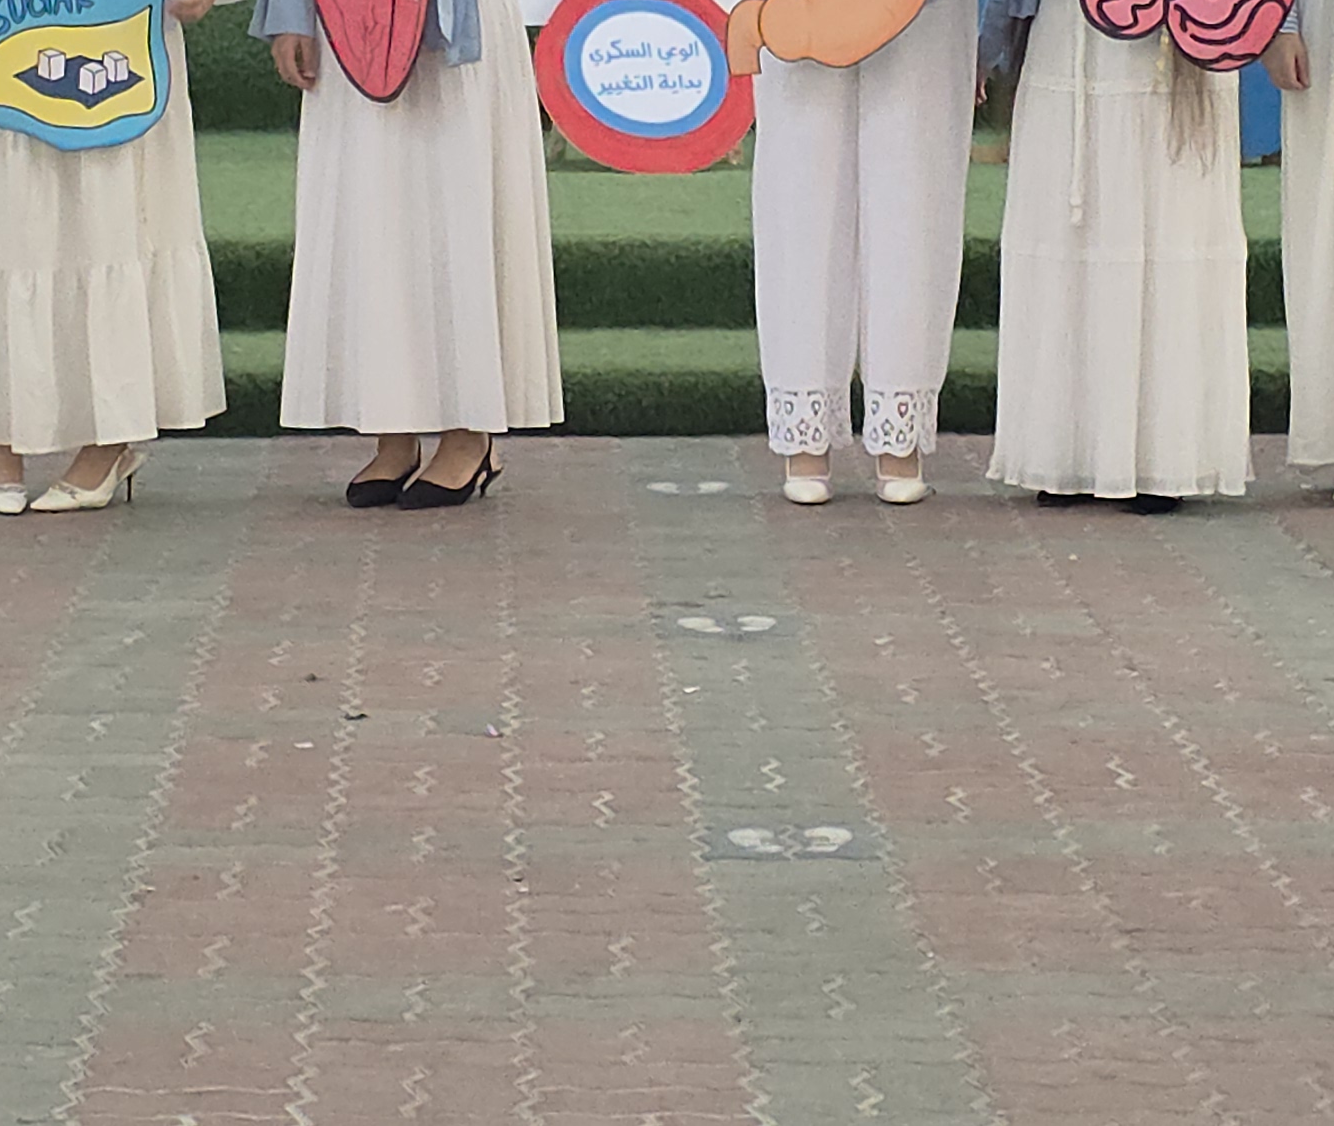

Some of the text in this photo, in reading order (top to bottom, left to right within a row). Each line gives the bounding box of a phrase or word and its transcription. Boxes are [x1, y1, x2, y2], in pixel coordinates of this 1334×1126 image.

[589, 39, 700, 67] الوعي السكري
[597, 73, 703, 96] بداية التغيير
